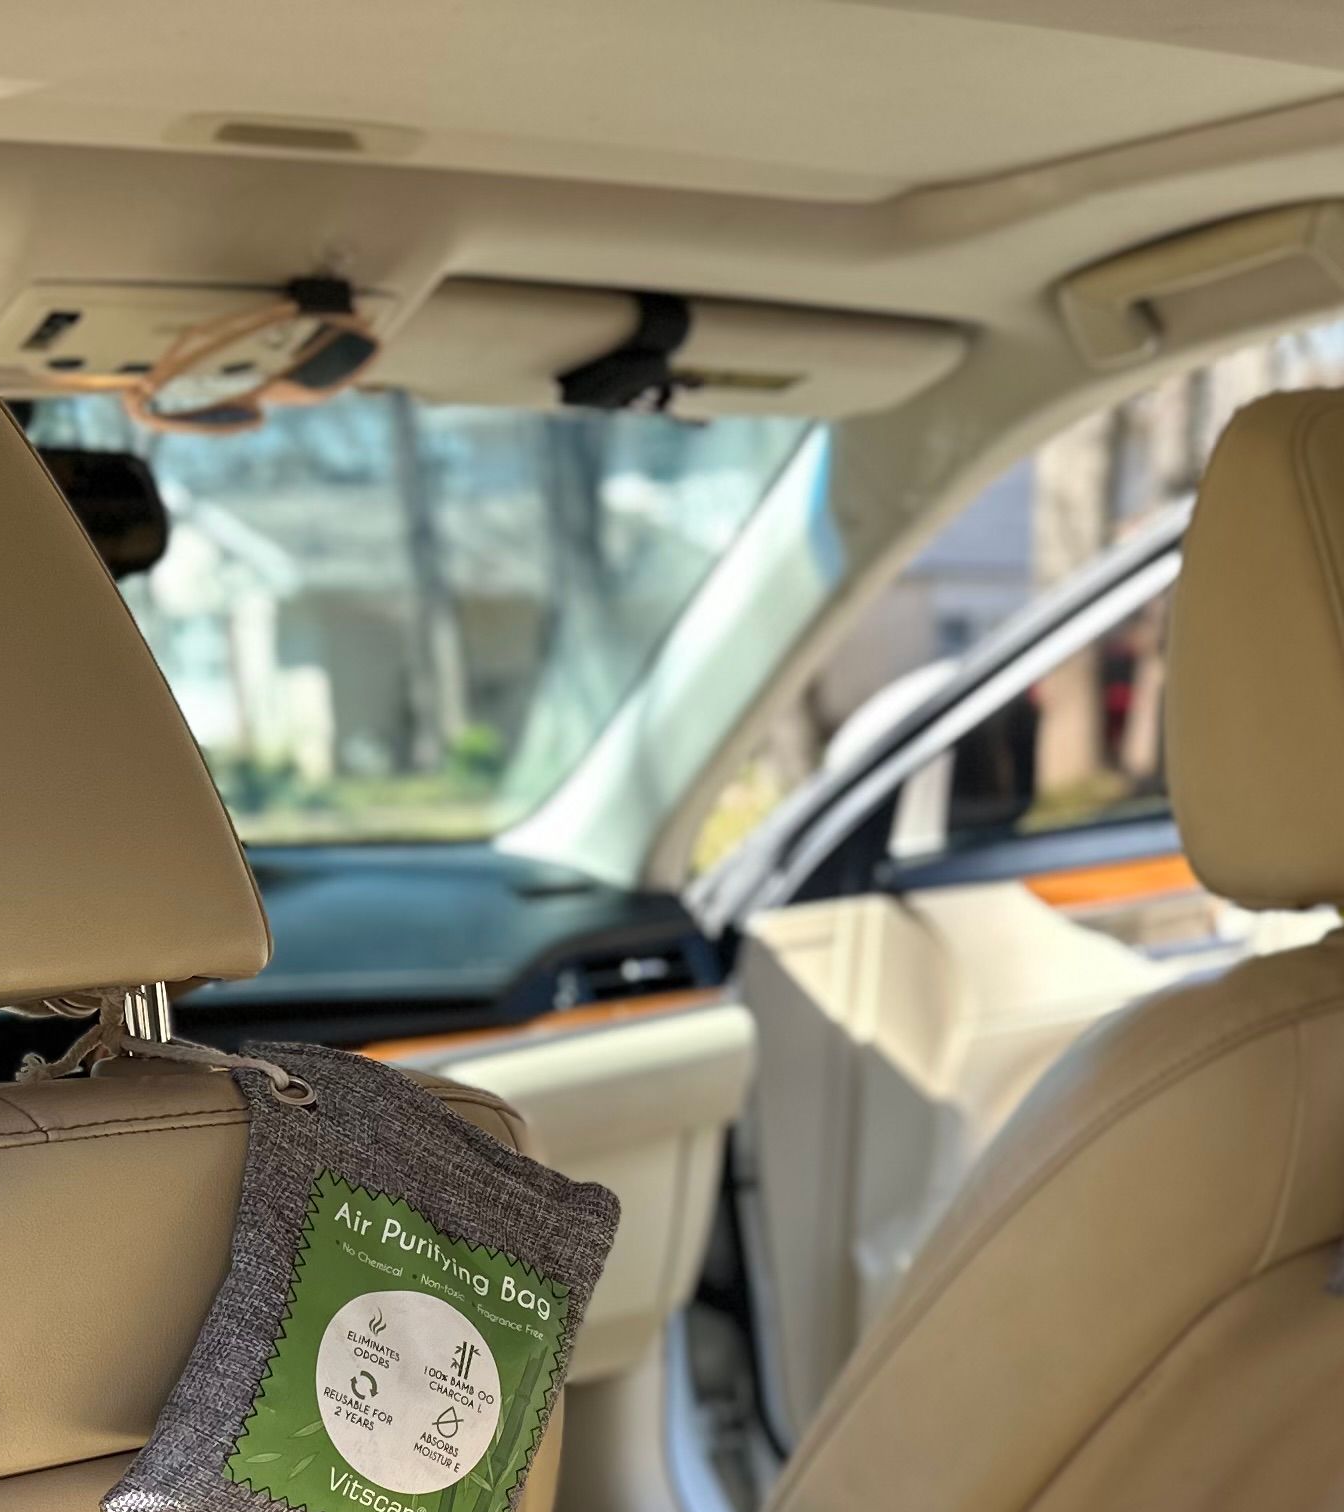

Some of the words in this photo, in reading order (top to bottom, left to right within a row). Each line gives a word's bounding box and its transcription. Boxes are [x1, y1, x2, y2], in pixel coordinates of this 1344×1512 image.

[334, 1202, 372, 1236] Air
[381, 1218, 490, 1297] Purifying
[501, 1275, 551, 1321] Bag
[342, 1242, 356, 1256] No
[358, 1252, 404, 1278] Chemical
[476, 1303, 523, 1332] Fragrance
[525, 1324, 545, 1341] Free
[346, 1330, 400, 1362] ELIMINATES
[353, 1346, 390, 1369] ODORS
[323, 1386, 370, 1415] REUSABLE
[372, 1408, 393, 1426] FOR
[334, 1405, 342, 1417] 2
[345, 1411, 375, 1431] YEARS
[413, 1442, 461, 1474] MOISTURE
[420, 1431, 459, 1458] ABSORBS
